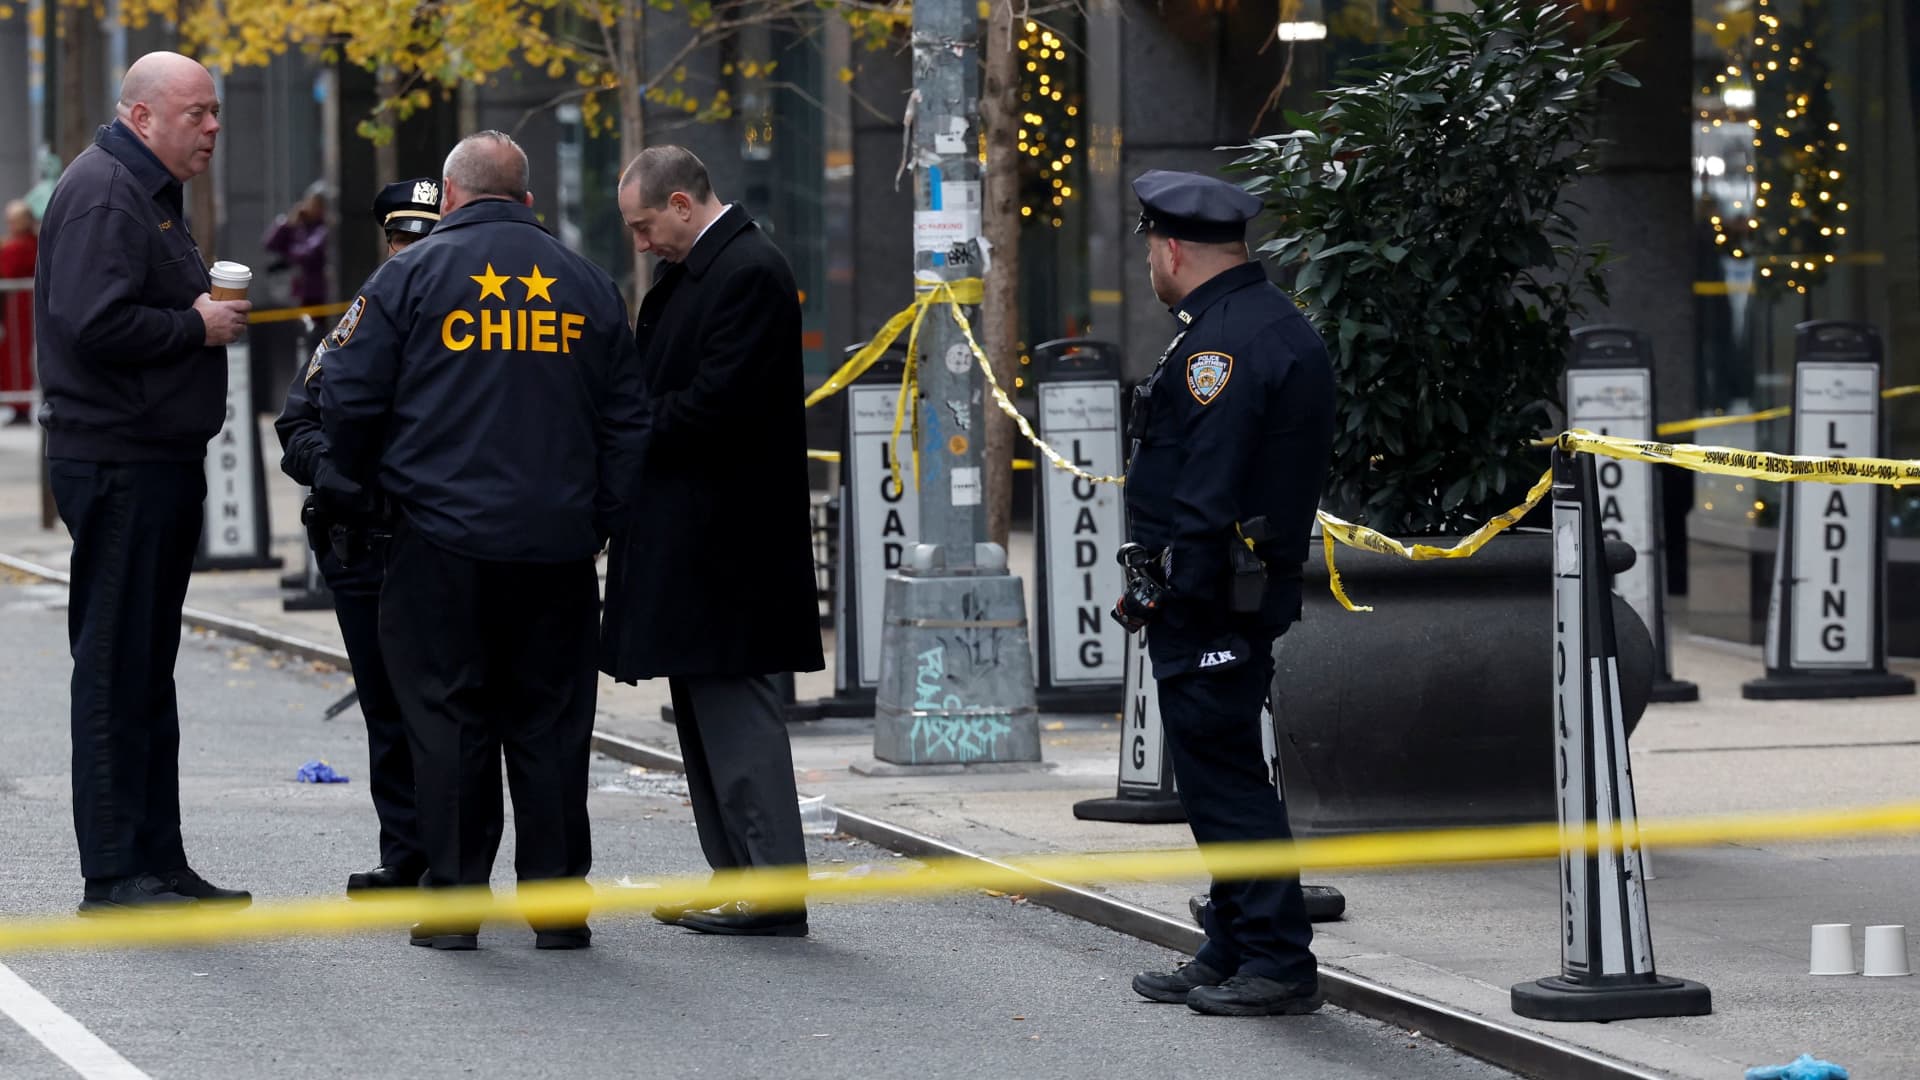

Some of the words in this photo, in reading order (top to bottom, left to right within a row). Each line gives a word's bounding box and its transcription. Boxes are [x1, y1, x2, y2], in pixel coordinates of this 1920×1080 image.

[441, 309, 586, 354] CHIEF
[1190, 360, 1227, 370] DEPARTMENT
[1746, 455, 1758, 470] DO
[1764, 456, 1789, 475] SCENE
[1789, 460, 1814, 475] CRIME
[1821, 420, 1850, 654] LADING
[1072, 438, 1105, 669] LOADING
